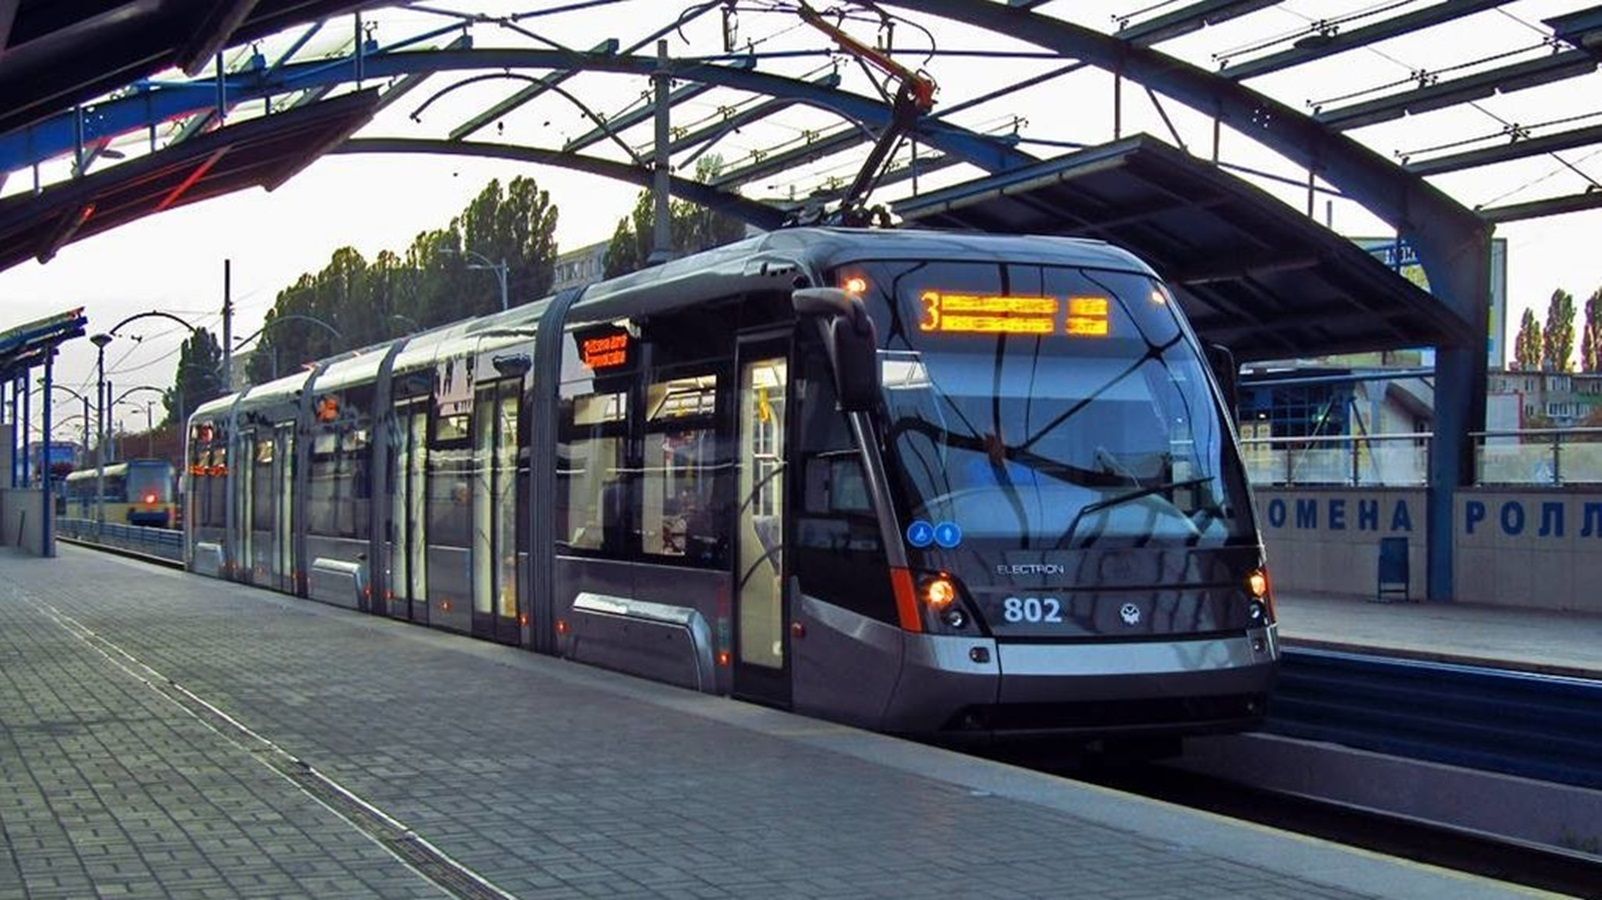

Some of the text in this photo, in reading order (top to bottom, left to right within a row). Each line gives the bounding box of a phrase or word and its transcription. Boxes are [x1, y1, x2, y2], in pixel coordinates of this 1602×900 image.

[920, 291, 939, 331] 3
[996, 564, 1065, 575] ELECTRON
[1004, 597, 1062, 622] 802
